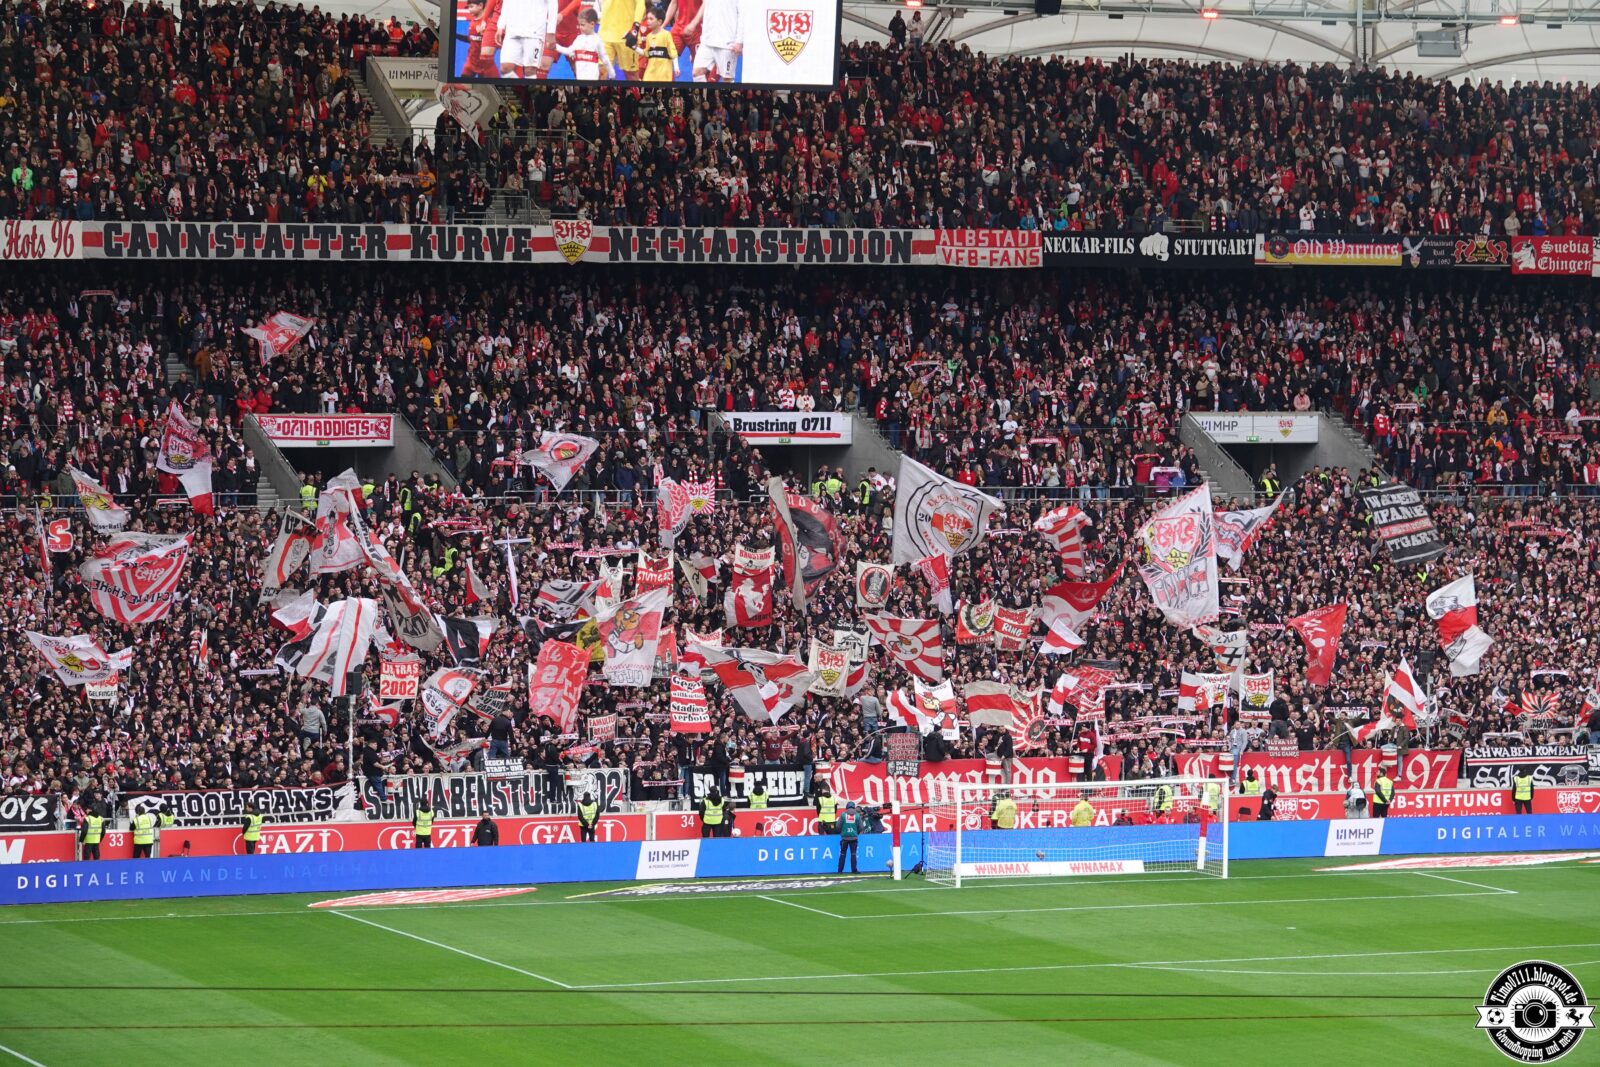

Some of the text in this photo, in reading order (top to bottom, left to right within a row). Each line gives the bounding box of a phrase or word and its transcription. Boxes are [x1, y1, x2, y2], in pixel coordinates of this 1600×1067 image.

[770, 11, 811, 35] VfB
[534, 48, 540, 59] 2
[399, 70, 422, 80] MHP
[51, 219, 74, 258] 96
[103, 222, 532, 262] CANNSTATTER KURVE
[608, 228, 913, 264] NECKARSTADION
[939, 229, 1041, 248] ALBSTADT
[1043, 236, 1135, 255] NECKAR-FILS
[1174, 238, 1255, 256] STUTTGART
[1293, 238, 1324, 259] Old
[1327, 238, 1400, 260] Warriors
[1540, 240, 1590, 255] Suebia
[941, 248, 1041, 267] VFB-FANS
[1538, 257, 1592, 274] Ehingen
[313, 419, 370, 437] ADDICTS
[733, 417, 832, 435] Brustring 0711
[1213, 420, 1239, 431] MHP
[1001, 622, 1023, 637] RING
[380, 679, 417, 696] 2002
[1464, 746, 1533, 758] SCHWABEN
[1405, 755, 1459, 791] 97
[161, 787, 333, 817] HOOLIGANS
[1176, 801, 1189, 813] 35
[1389, 792, 1502, 810] fB-STIFTUNG
[681, 814, 695, 829] 34
[109, 833, 124, 848] 33
[1348, 828, 1375, 839] MHP
[1437, 825, 1546, 840] DIGITALER
[661, 849, 690, 862] MHP
[758, 847, 875, 862] DIGITAER
[974, 861, 1125, 875] WINAMAX WINAMAX
[17, 871, 146, 890] DIGITALER
